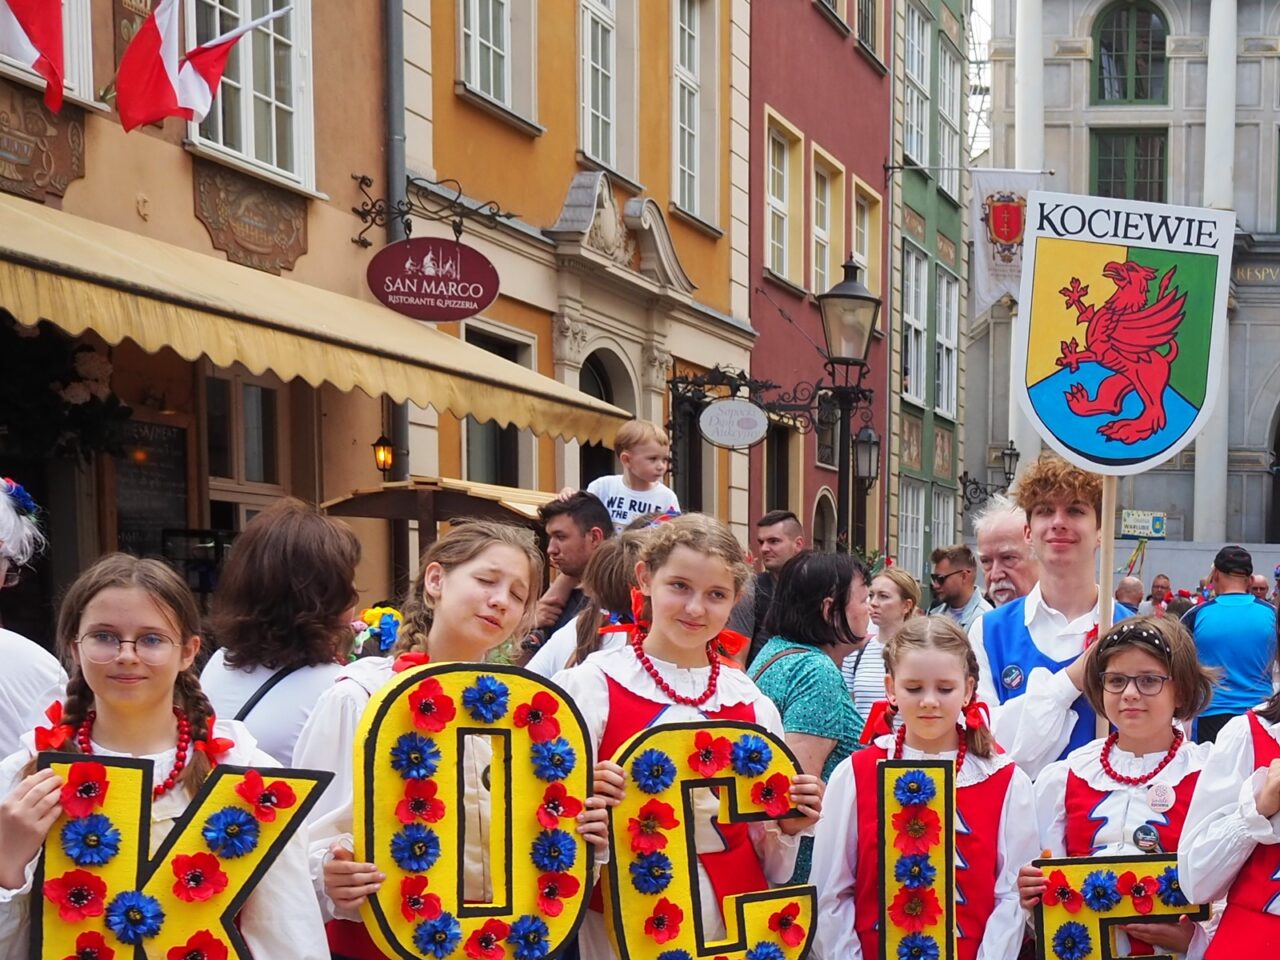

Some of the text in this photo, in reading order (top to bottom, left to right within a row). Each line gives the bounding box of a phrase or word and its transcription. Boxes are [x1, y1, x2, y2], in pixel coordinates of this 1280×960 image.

[1036, 202, 1220, 249] KOCIEWIE
[383, 276, 483, 298] SAN MARCO
[388, 294, 435, 306] RISTORANTE
[444, 299, 479, 309] PIZZERIA
[606, 496, 625, 509] WE
[611, 509, 628, 520] THE
